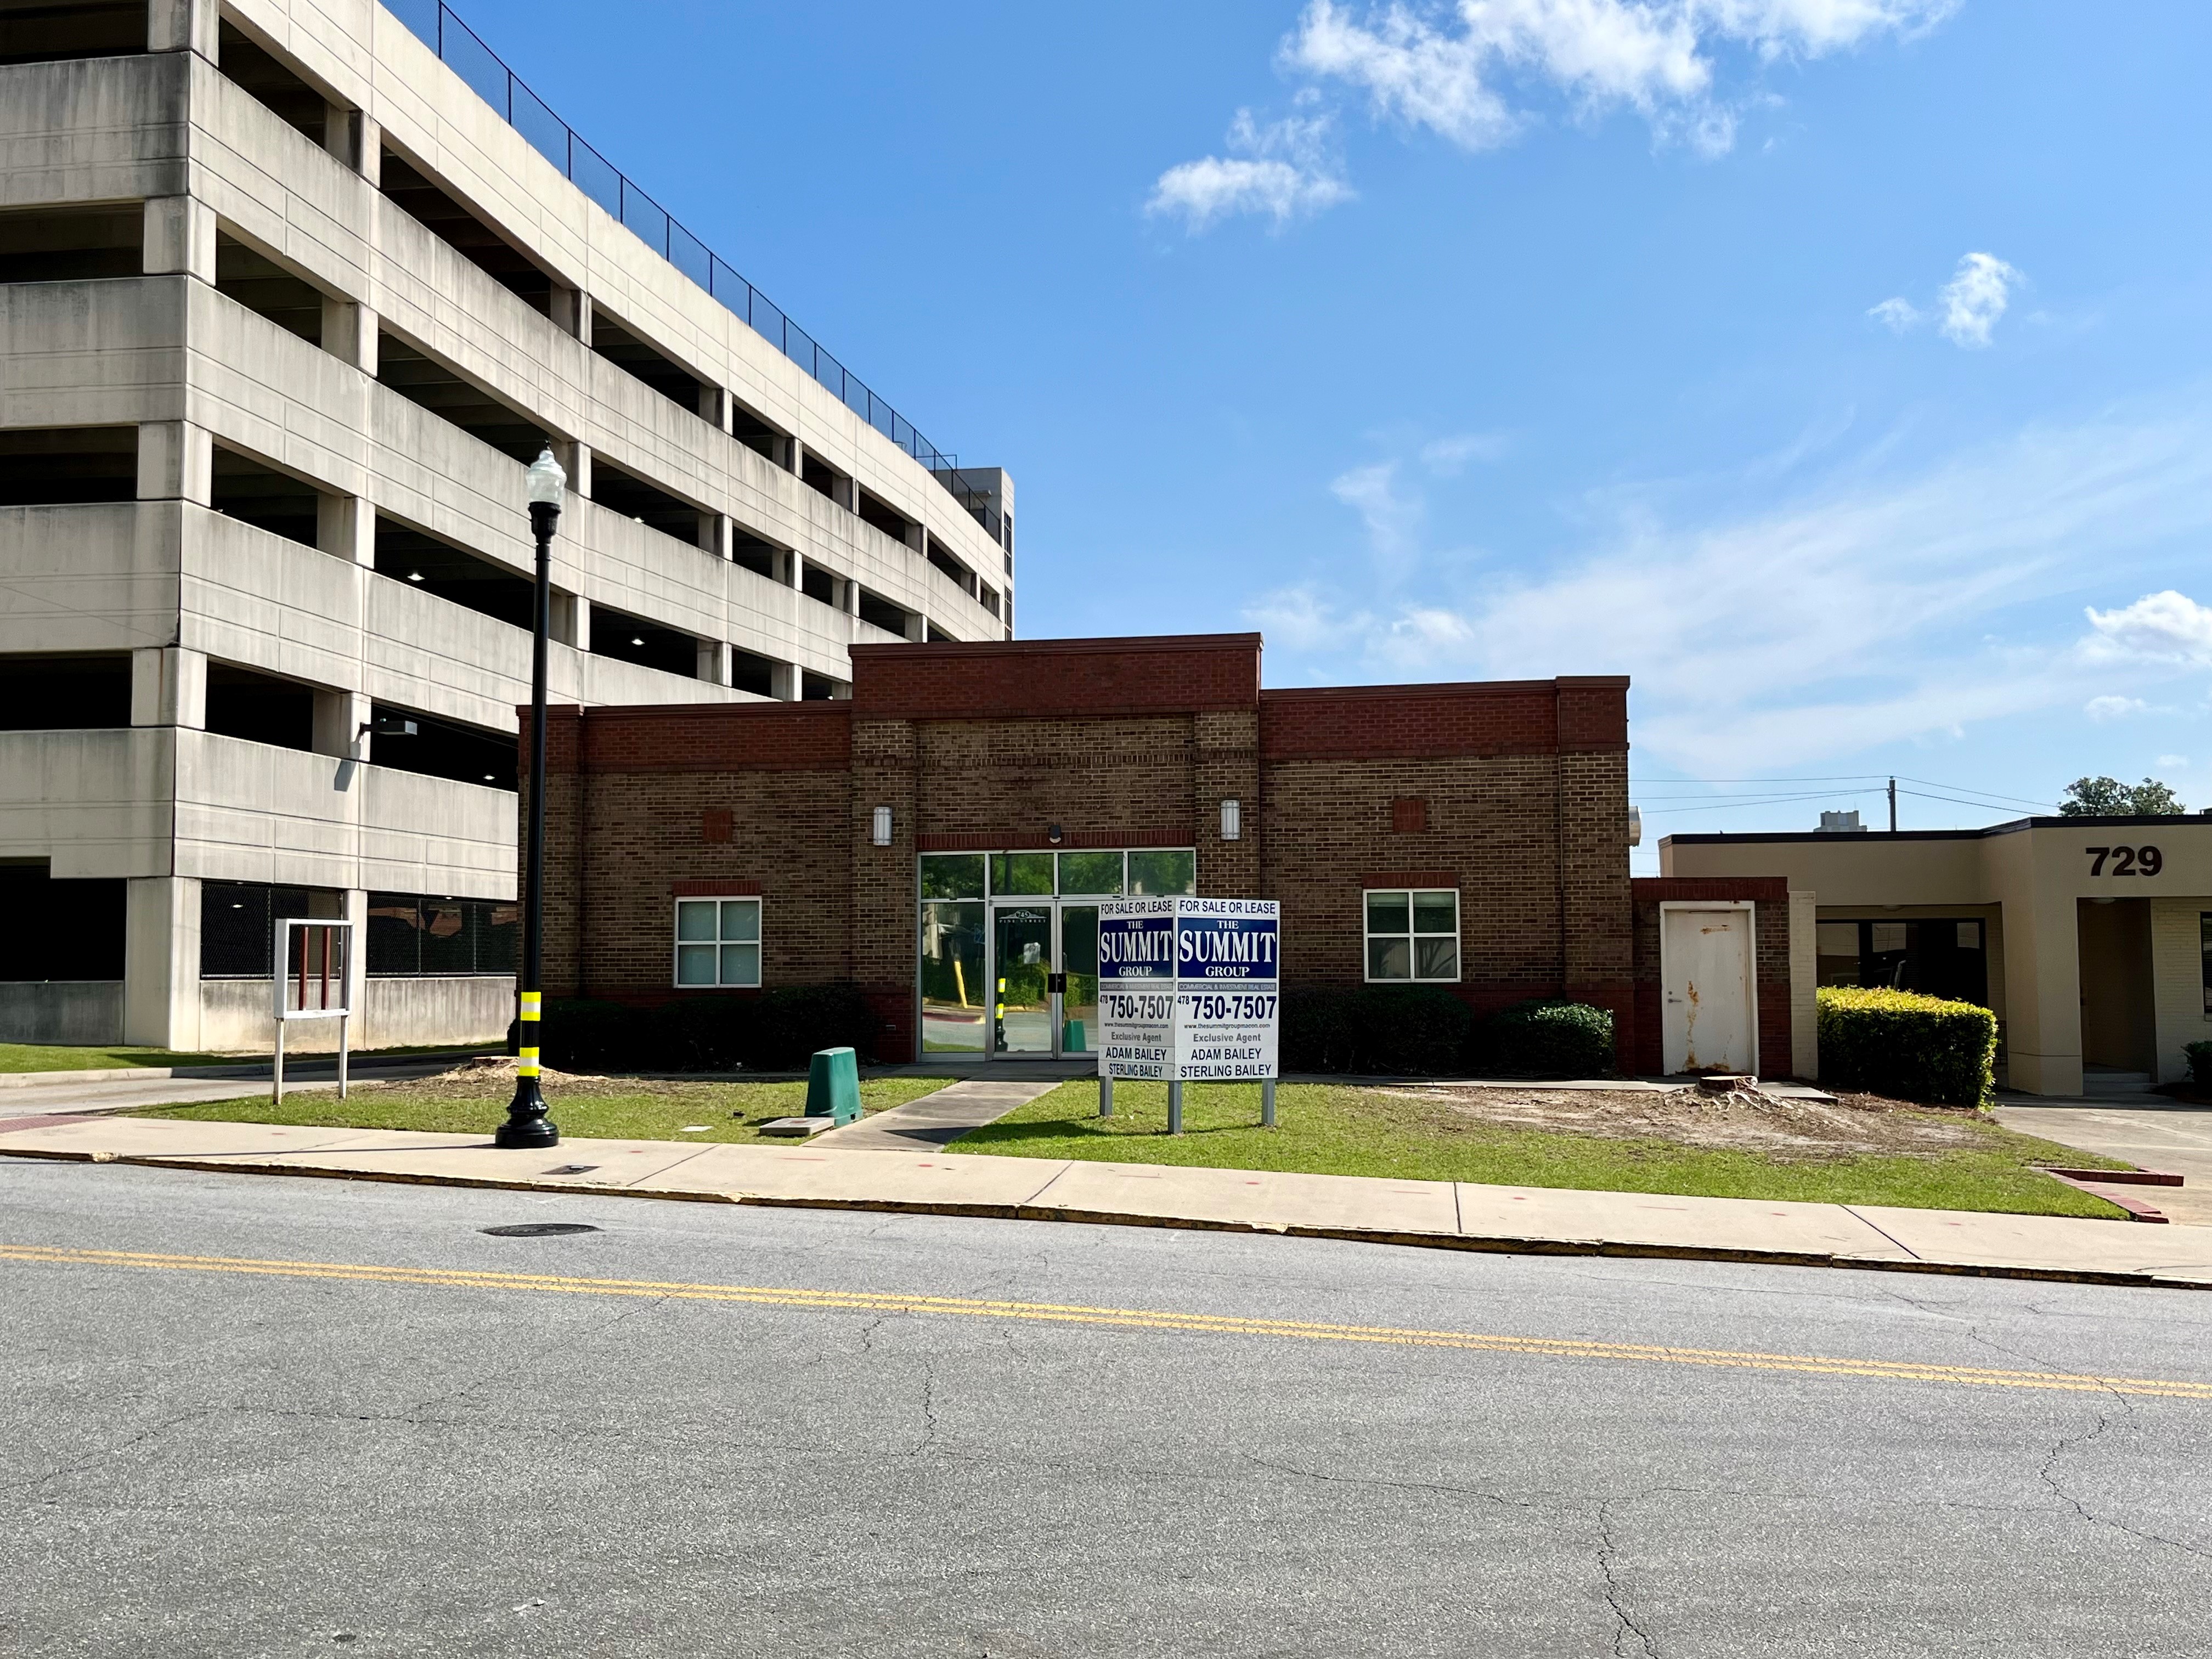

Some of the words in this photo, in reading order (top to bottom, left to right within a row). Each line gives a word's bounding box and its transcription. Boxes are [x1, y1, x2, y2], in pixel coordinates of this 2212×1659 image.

[2086, 845, 2162, 876] 729
[1101, 903, 1114, 915] FOR
[1115, 902, 1133, 913] SALE
[1135, 902, 1146, 912] OR
[1148, 900, 1172, 912] LEASE
[1180, 900, 1199, 912] FOR
[1202, 901, 1226, 913] SALE
[1229, 901, 1242, 913] OR
[1245, 902, 1275, 914] LEASE
[1127, 921, 1143, 929] THE
[1217, 921, 1239, 929] THE
[1101, 930, 1172, 962] SUMMIT
[1179, 930, 1276, 962] SUMMIT
[1119, 966, 1152, 977] GROUP
[1205, 966, 1250, 977] GROUP
[1109, 995, 1173, 1019] 750-7507
[1178, 996, 1189, 1005] 478
[1192, 996, 1277, 1019] 750-7507
[1111, 1032, 1141, 1041] Exclusive
[1143, 1033, 1161, 1043] Agent
[1193, 1034, 1233, 1042] Exclusive
[1236, 1034, 1261, 1043] Agent
[1106, 1047, 1132, 1059] ADAM
[1135, 1048, 1166, 1061] BAILEY
[1192, 1049, 1221, 1060] ADAM
[1224, 1048, 1261, 1059] BAILEY
[1109, 1063, 1138, 1076] STERLING
[1139, 1065, 1163, 1077] BAILEY
[1181, 1065, 1231, 1077] STERLING
[1235, 1064, 1271, 1076] BAILEY
